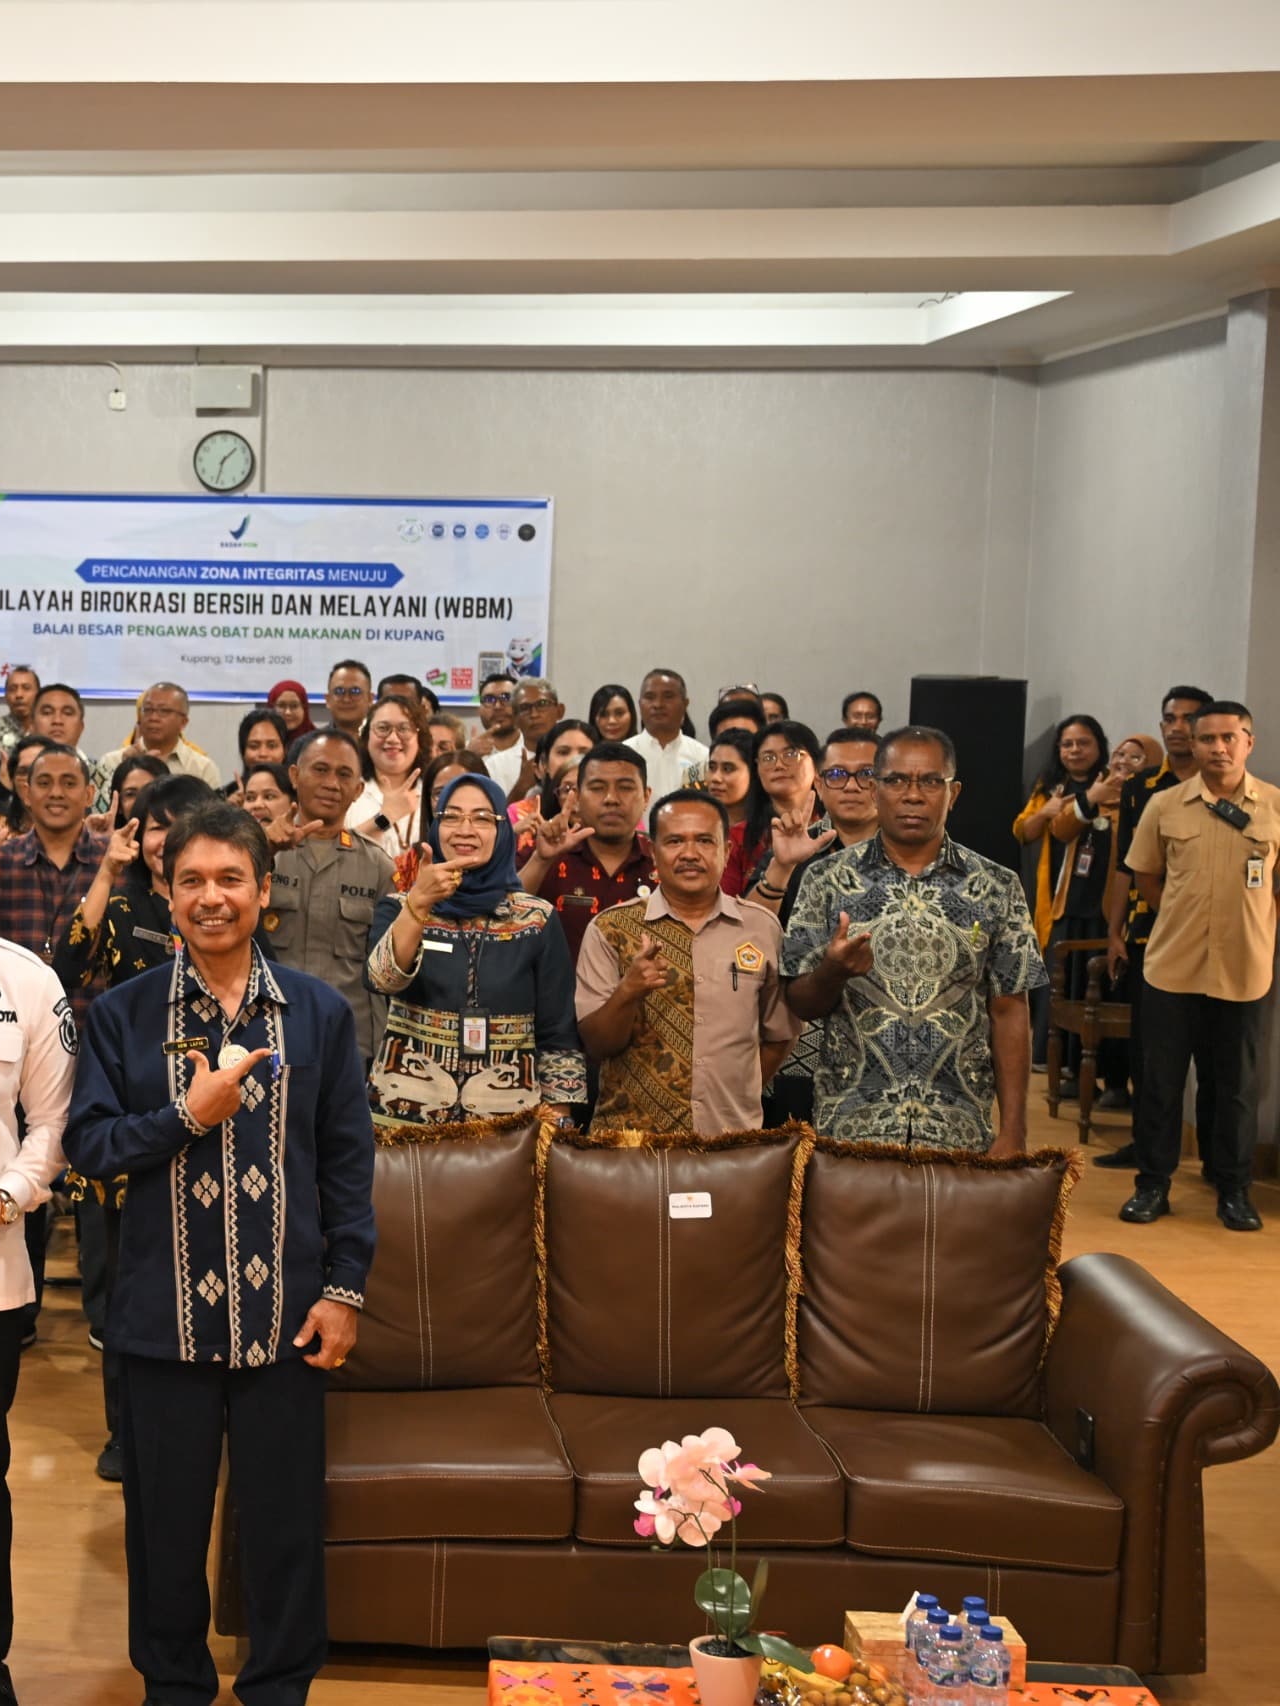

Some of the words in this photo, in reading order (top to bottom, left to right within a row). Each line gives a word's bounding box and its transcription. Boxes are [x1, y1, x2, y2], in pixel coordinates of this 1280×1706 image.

[91, 564, 198, 580] PENCANANGAN
[200, 565, 241, 580] ZONA
[243, 567, 325, 581] INTEGRITAS
[327, 569, 388, 583] MENUJU
[80, 590, 186, 614] BIROKRASI
[193, 592, 264, 615] BERSIH
[271, 593, 312, 616] DAN
[320, 595, 427, 618] MELAYANI
[434, 597, 513, 621] (WBBM)
[32, 623, 74, 636] BALAI
[77, 623, 124, 637] BESAR
[126, 625, 208, 638] PENGAWAS
[210, 626, 249, 639] OBAT
[253, 627, 284, 640] DAN
[287, 628, 362, 641] MAKANAN
[365, 629, 380, 641] DI
[384, 630, 445, 642] KUPANG
[236, 655, 266, 665] Maret
[268, 655, 293, 665] 2026
[340, 883, 377, 899] POLR
